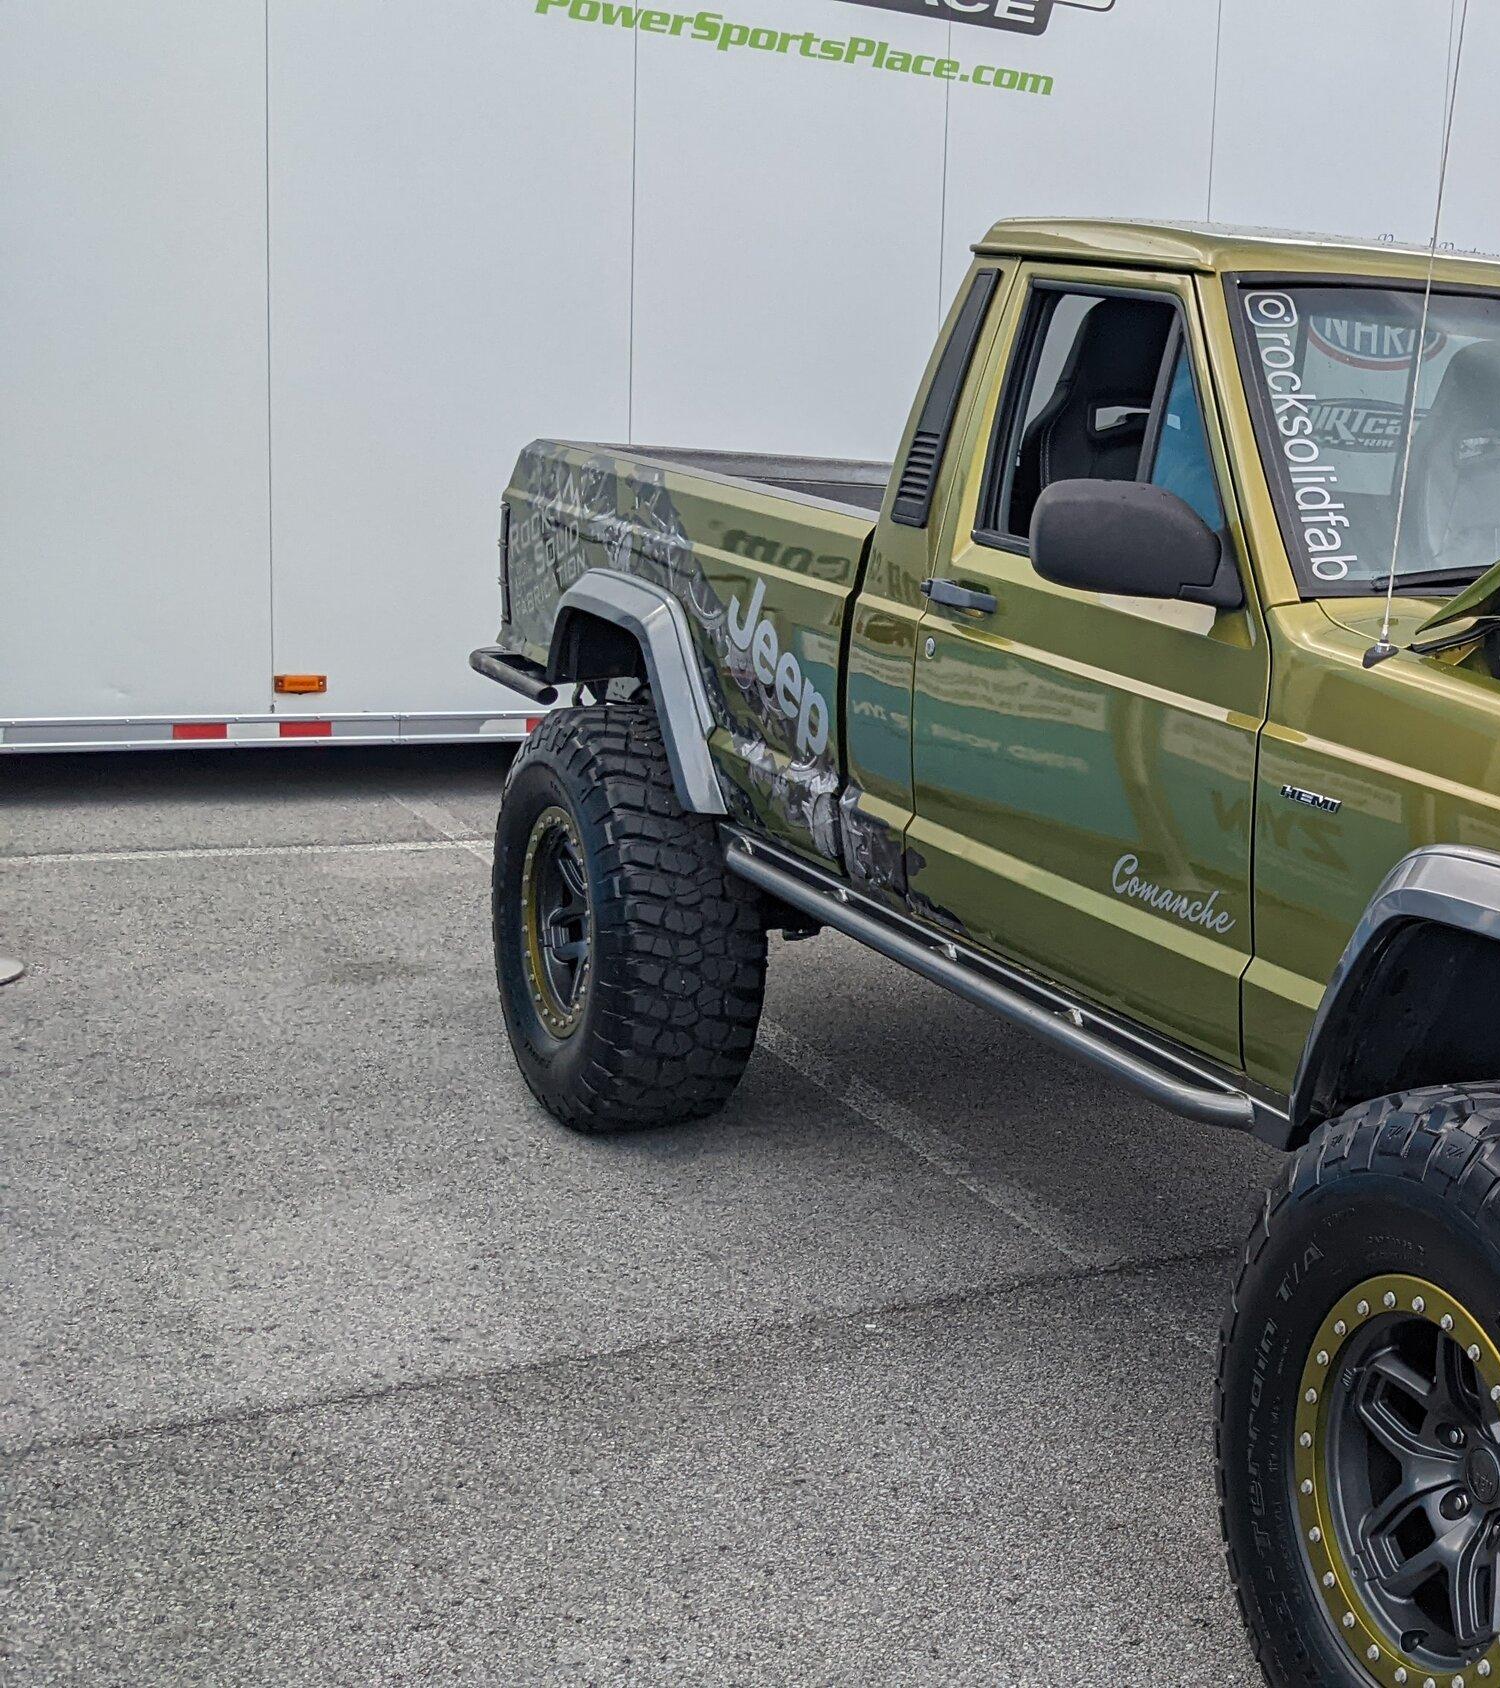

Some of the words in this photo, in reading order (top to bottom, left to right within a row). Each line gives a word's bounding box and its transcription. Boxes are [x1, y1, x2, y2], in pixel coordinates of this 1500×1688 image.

[534, 0, 1054, 96] PowerSportsPlace.com
[534, 520, 580, 576] SOLID
[727, 577, 829, 756] Jeep
[1279, 784, 1343, 814] HEMI
[1111, 853, 1236, 934] Comanche
